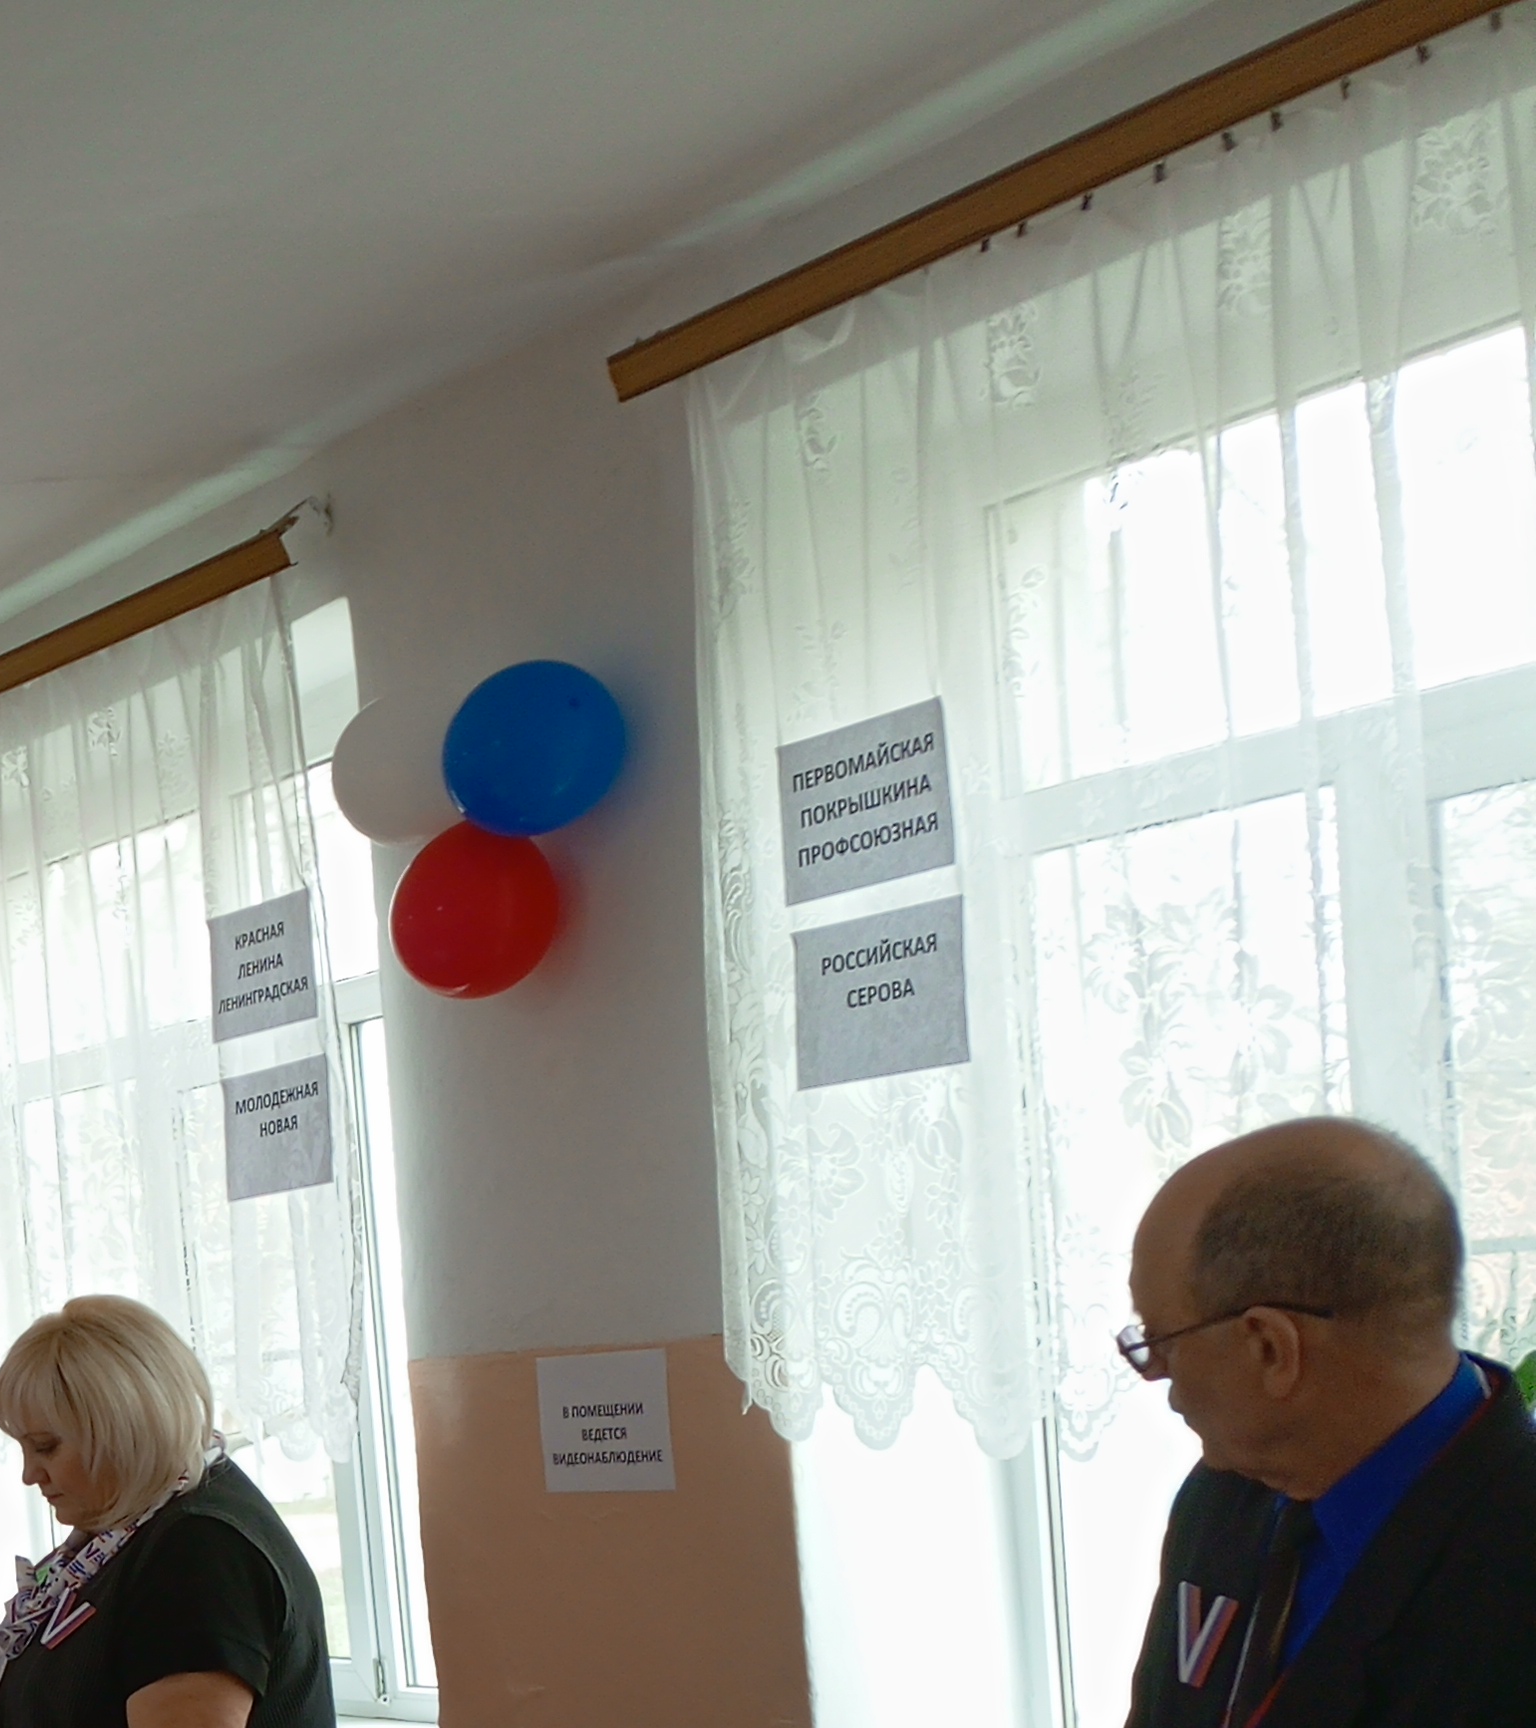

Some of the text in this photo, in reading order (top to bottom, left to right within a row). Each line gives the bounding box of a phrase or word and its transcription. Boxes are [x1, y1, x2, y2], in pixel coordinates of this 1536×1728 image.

[792, 731, 935, 793] ПЕРВОМАЙСКАЯ
[800, 773, 932, 828] ПОКРЫШКИНА
[798, 811, 939, 868] ПРОФСОЮЗНАЯ
[235, 921, 285, 950] КРАСНАЯ
[237, 953, 283, 980] ЛЕНИНА
[821, 933, 938, 975] РОССИЙСКАЯ
[218, 977, 309, 1015] ЛЕНИНГРАДСКАЯ
[847, 978, 915, 1008] СЕРОВА
[235, 1081, 319, 1116] МОЛОДЕЖНАЯ
[259, 1115, 299, 1137] НОВАЯ
[562, 1403, 644, 1419] В ПОМЕЩЕНИИ
[581, 1427, 628, 1442] ВЕДЕТСЯ
[553, 1449, 664, 1467] ВИДЕОНАБЛЮДЕНИЕ
